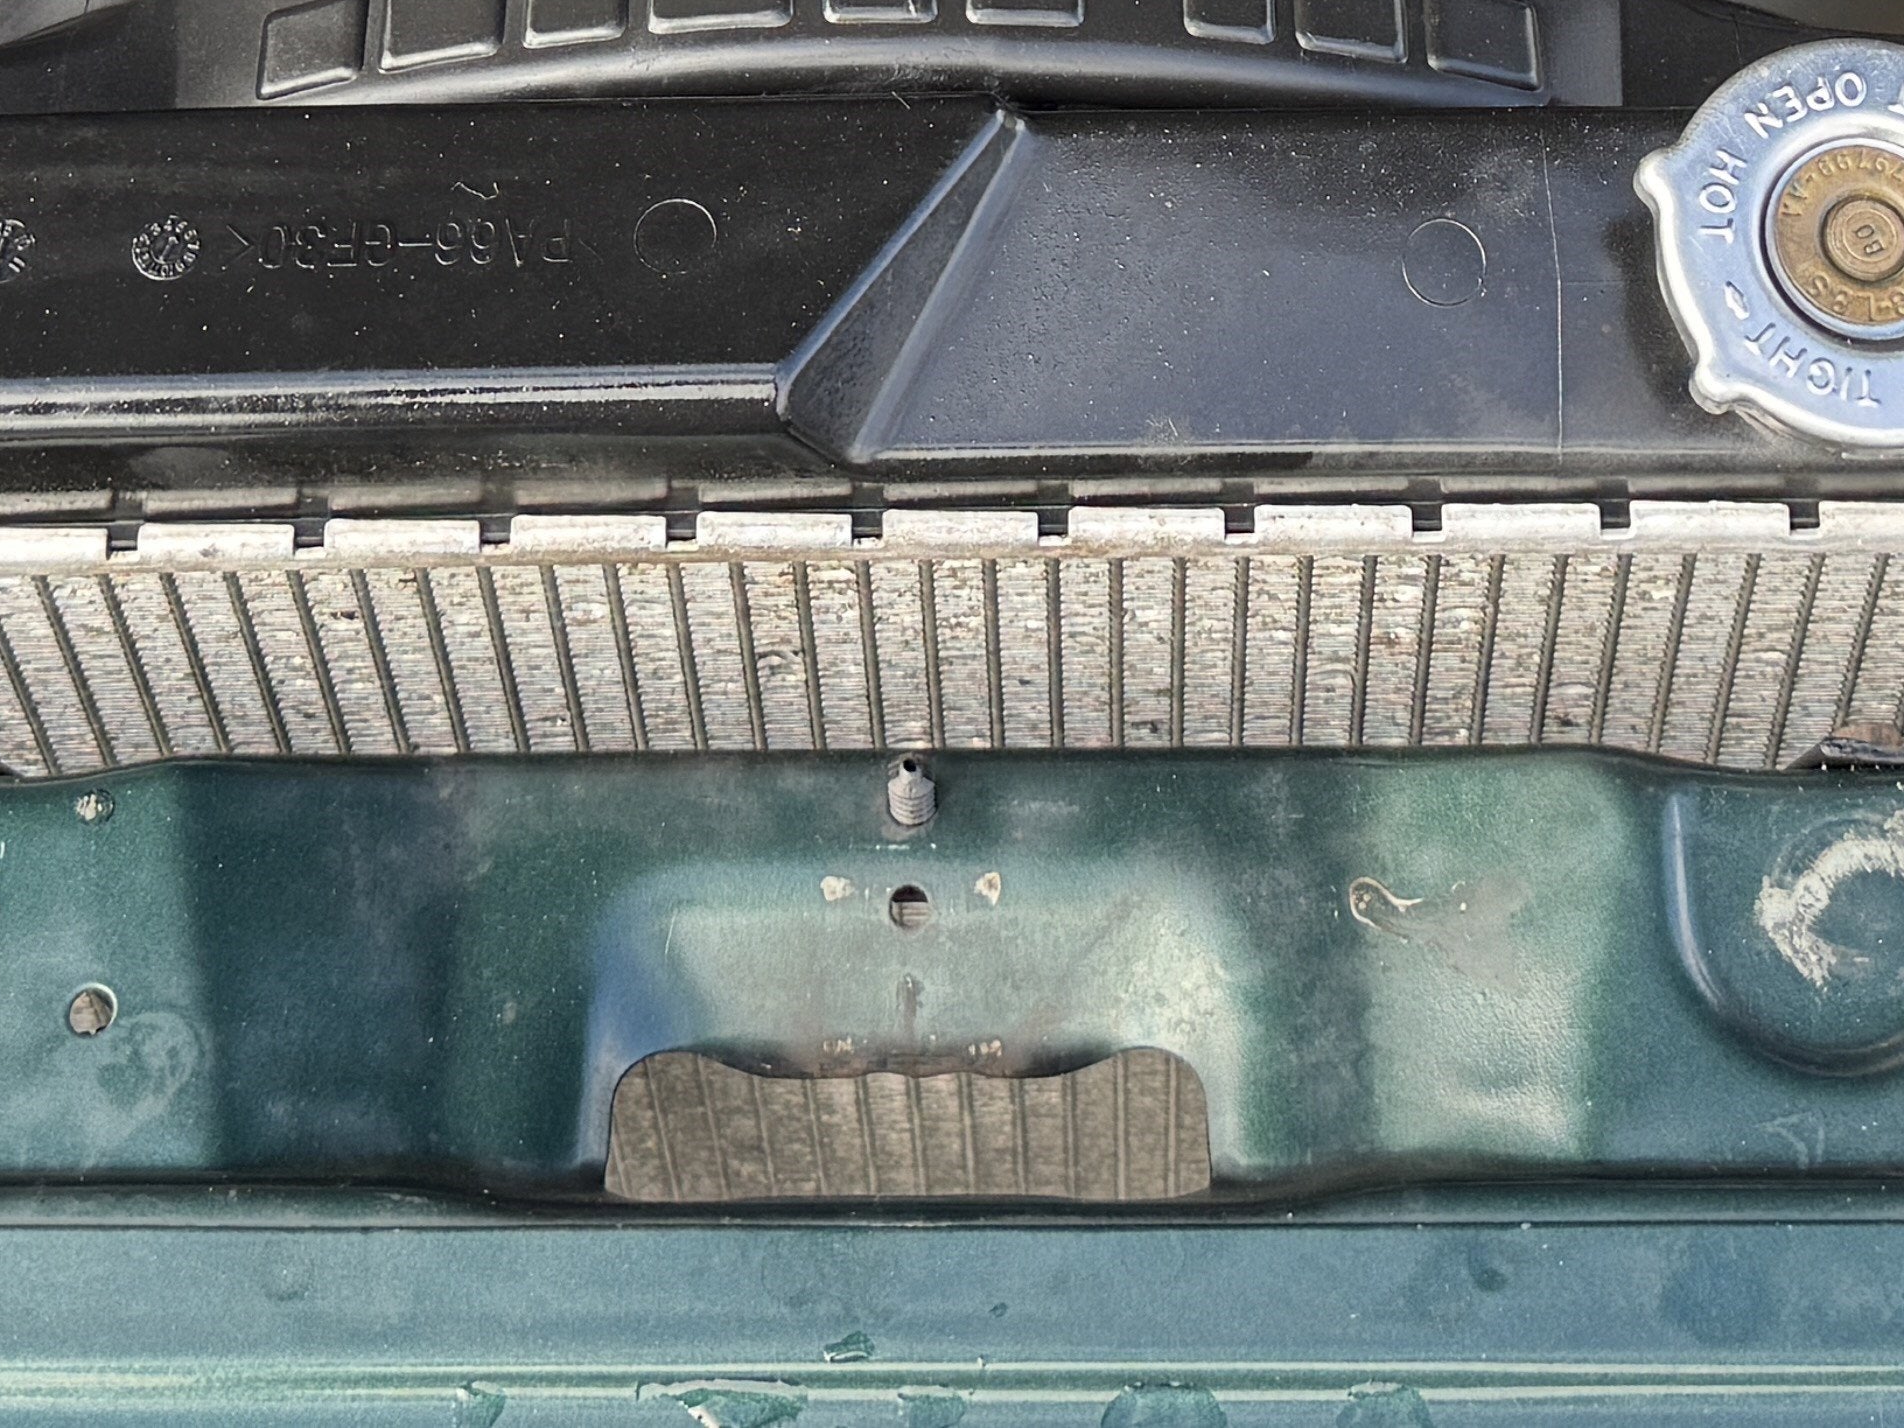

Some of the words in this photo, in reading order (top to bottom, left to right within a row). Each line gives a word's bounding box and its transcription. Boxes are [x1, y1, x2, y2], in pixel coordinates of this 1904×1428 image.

[1743, 70, 1869, 139] OPEN
[1698, 147, 1748, 244] HOT
[1742, 321, 1882, 409] TIGHT
